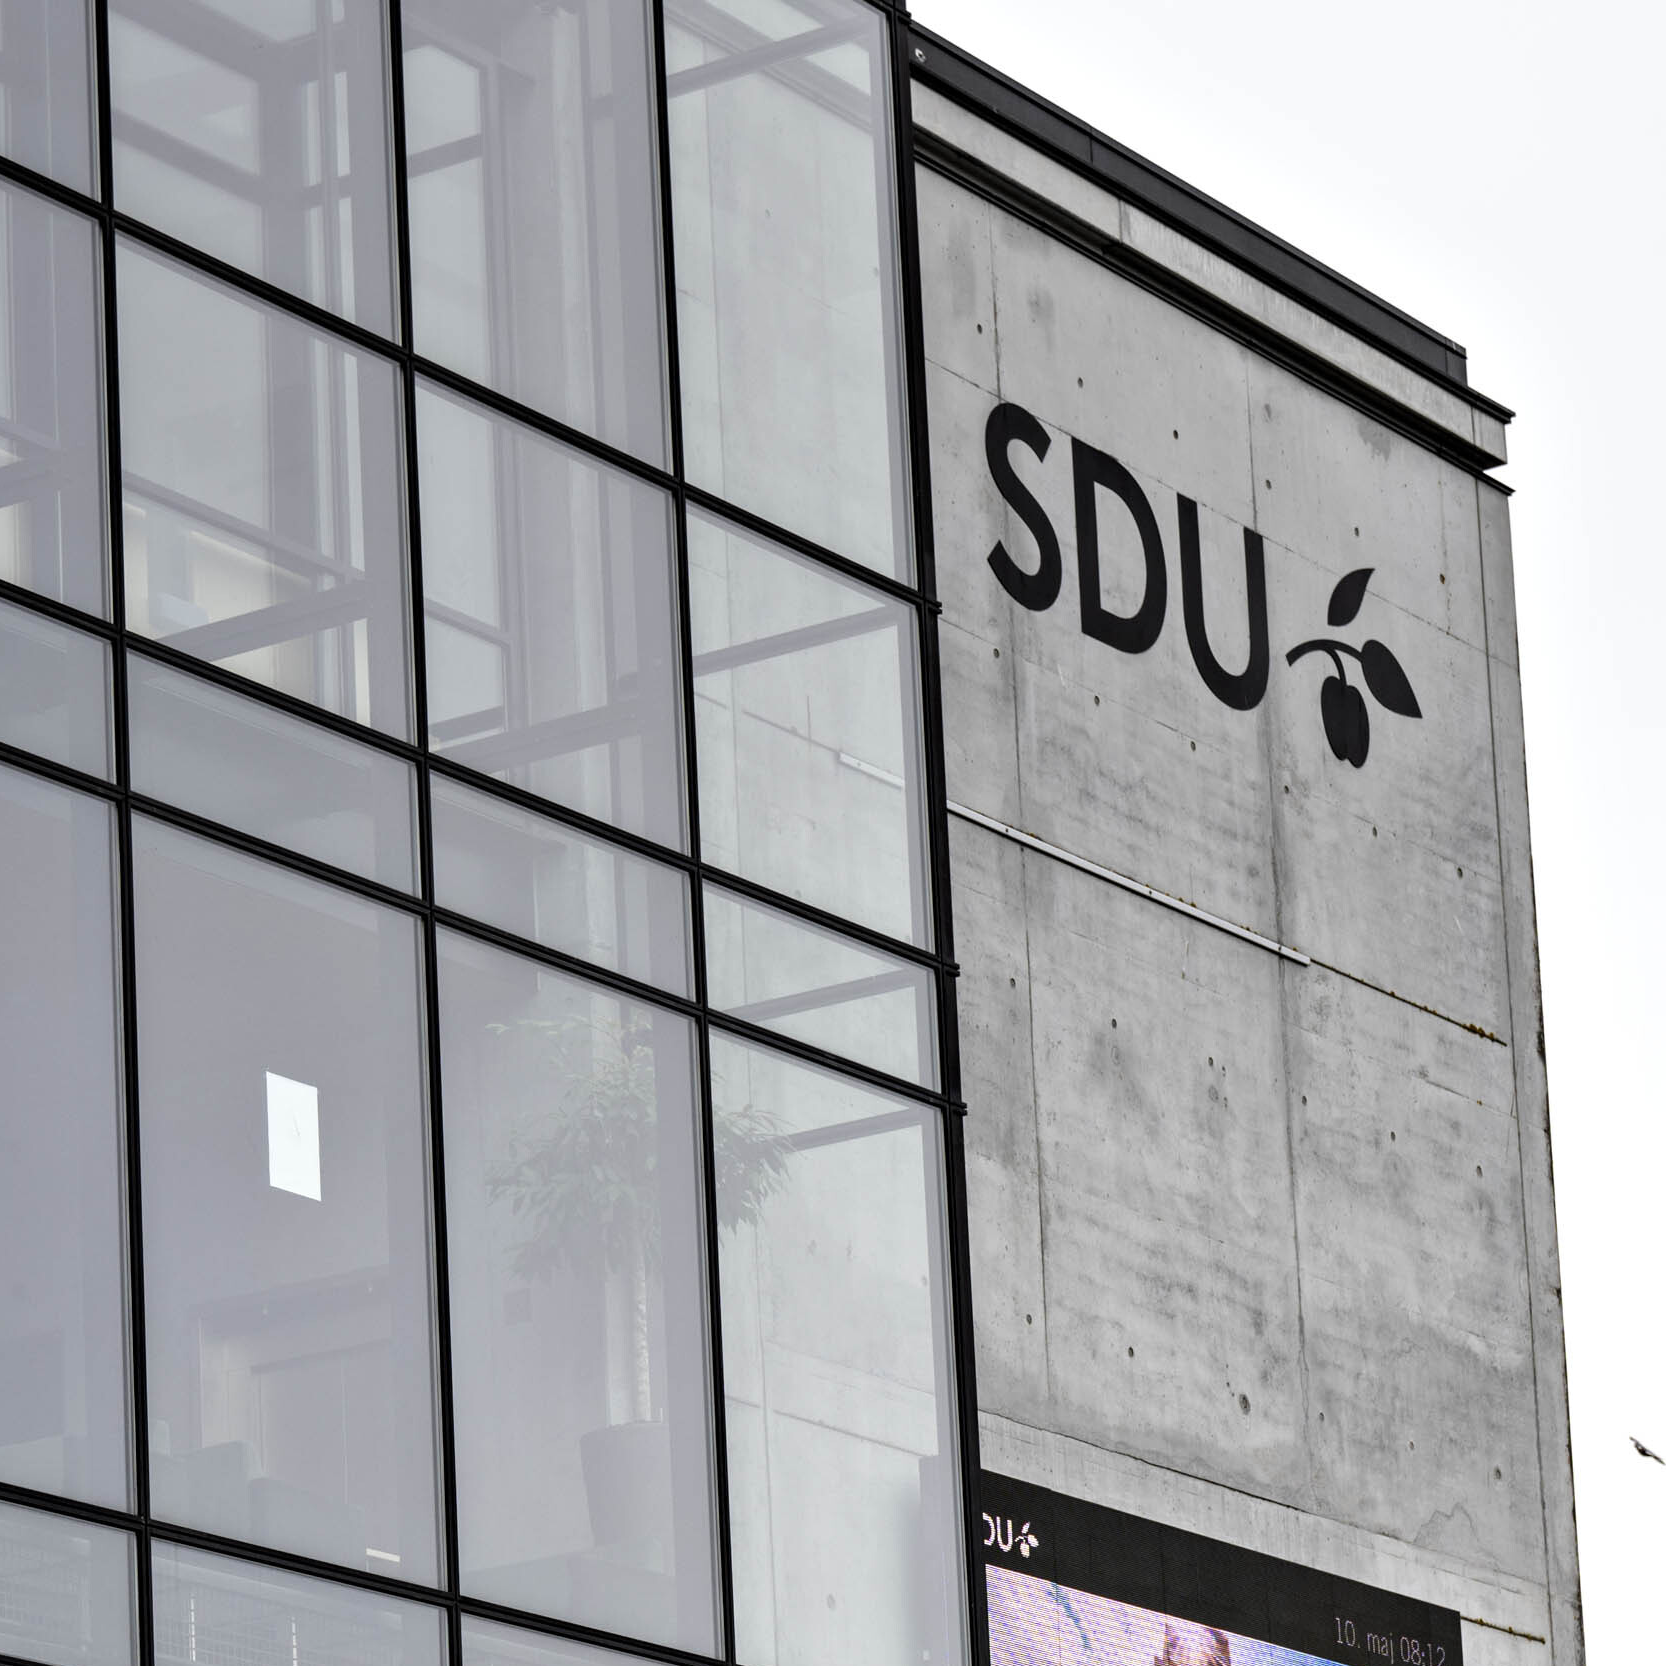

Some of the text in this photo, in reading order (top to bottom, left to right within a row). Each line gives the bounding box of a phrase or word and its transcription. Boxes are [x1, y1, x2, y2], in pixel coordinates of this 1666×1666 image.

[984, 402, 1271, 711] SDU
[1335, 1617, 1361, 1649] 10.
[1367, 1631, 1394, 1665] maj
